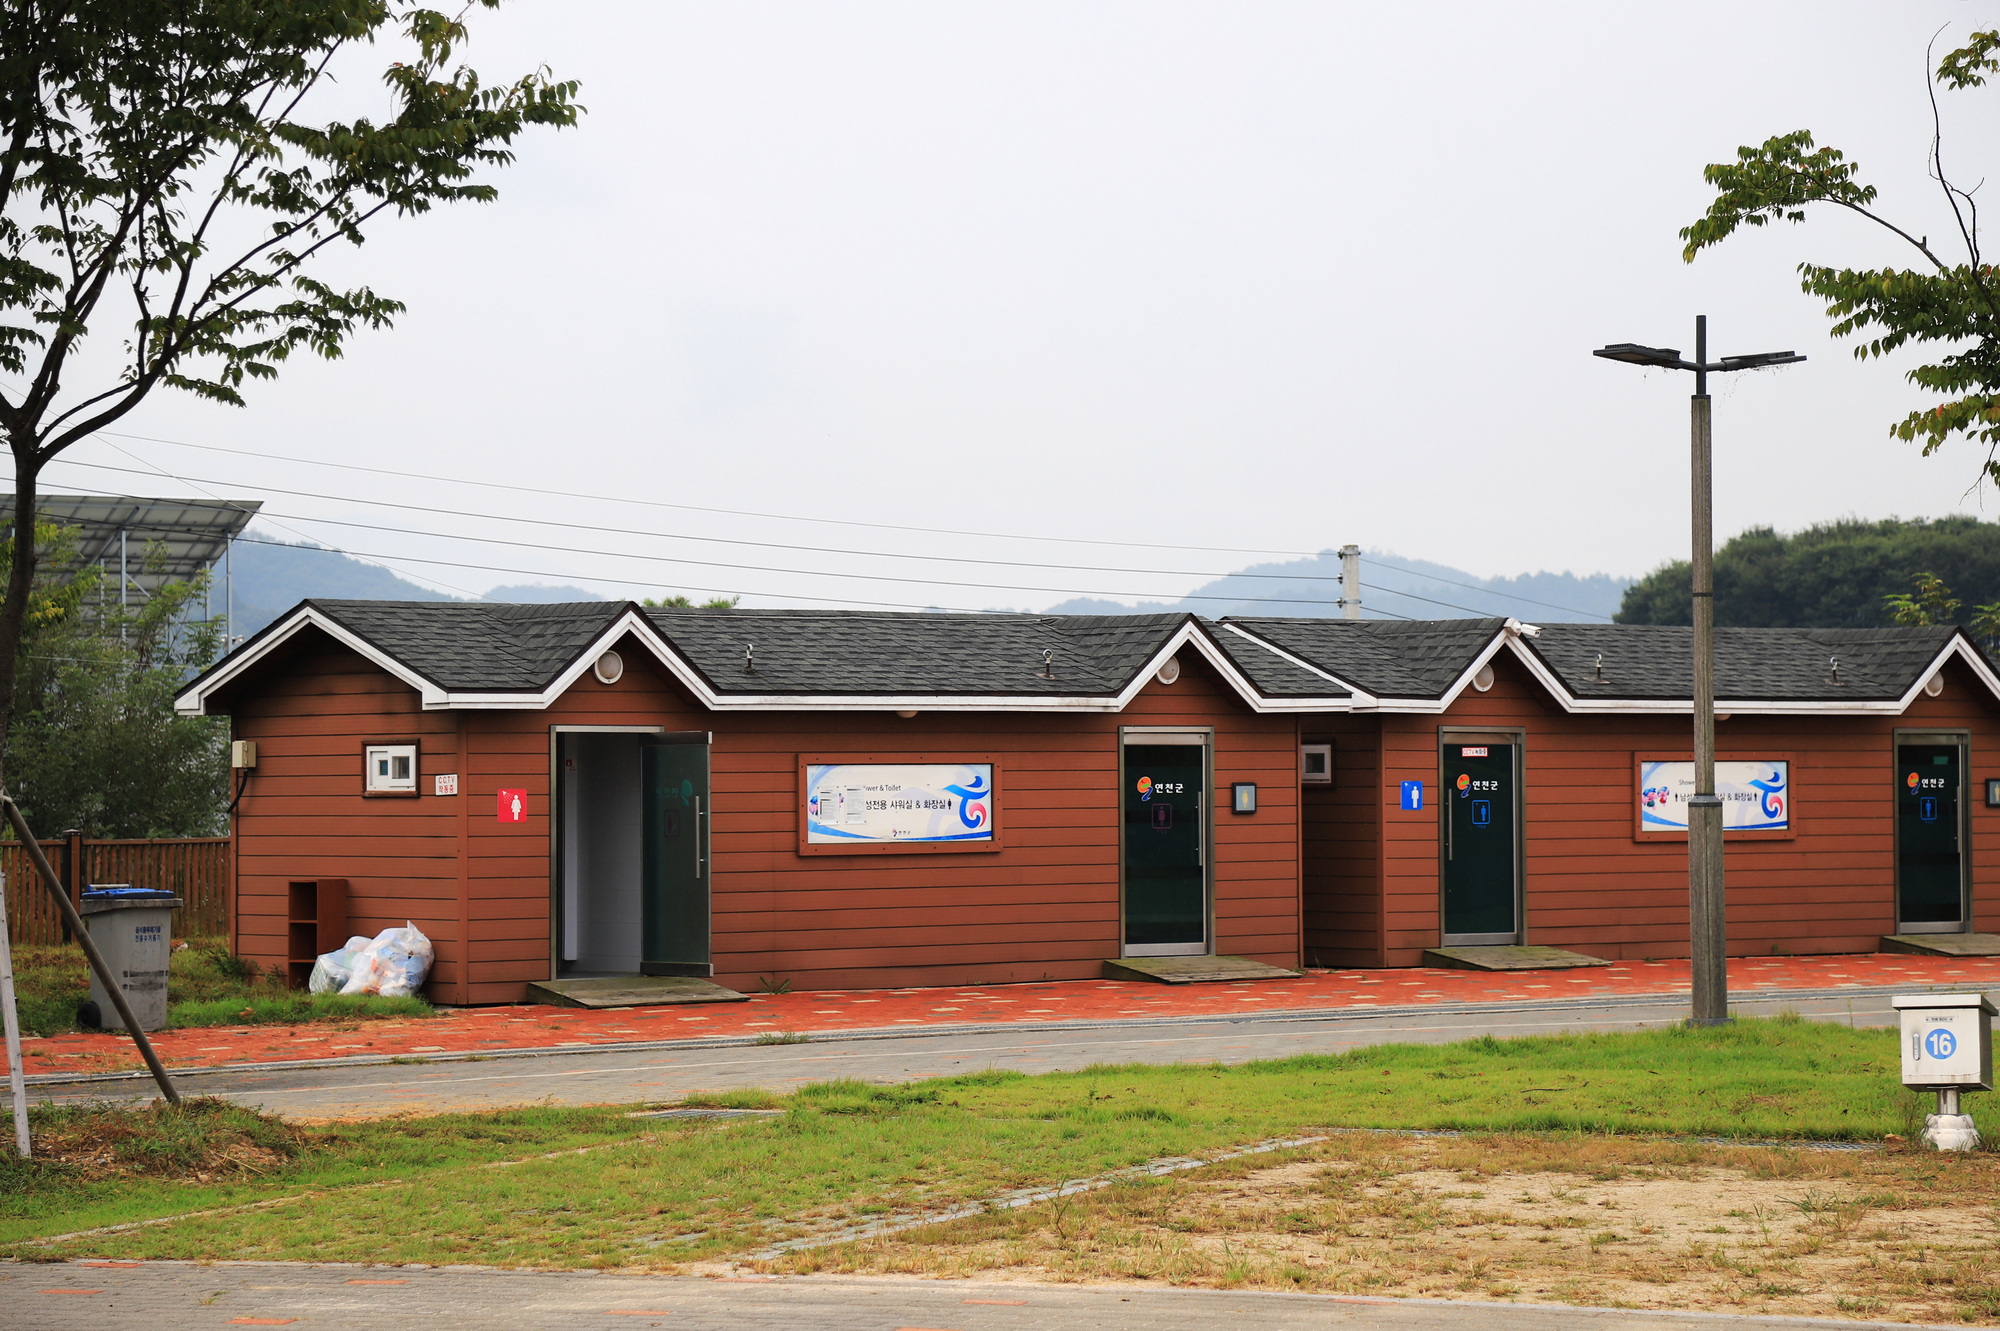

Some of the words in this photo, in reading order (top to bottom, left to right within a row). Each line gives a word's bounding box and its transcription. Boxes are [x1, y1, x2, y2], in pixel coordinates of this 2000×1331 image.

[438, 776, 455, 784] CCTV
[1472, 780, 1498, 791] 연천군
[1921, 778, 1945, 788] 연천군
[1154, 783, 1184, 794] 연천군
[890, 799, 912, 810] 샤워실
[915, 800, 921, 809] &
[923, 799, 946, 810] 화장실
[1929, 1033, 1952, 1056] 16
